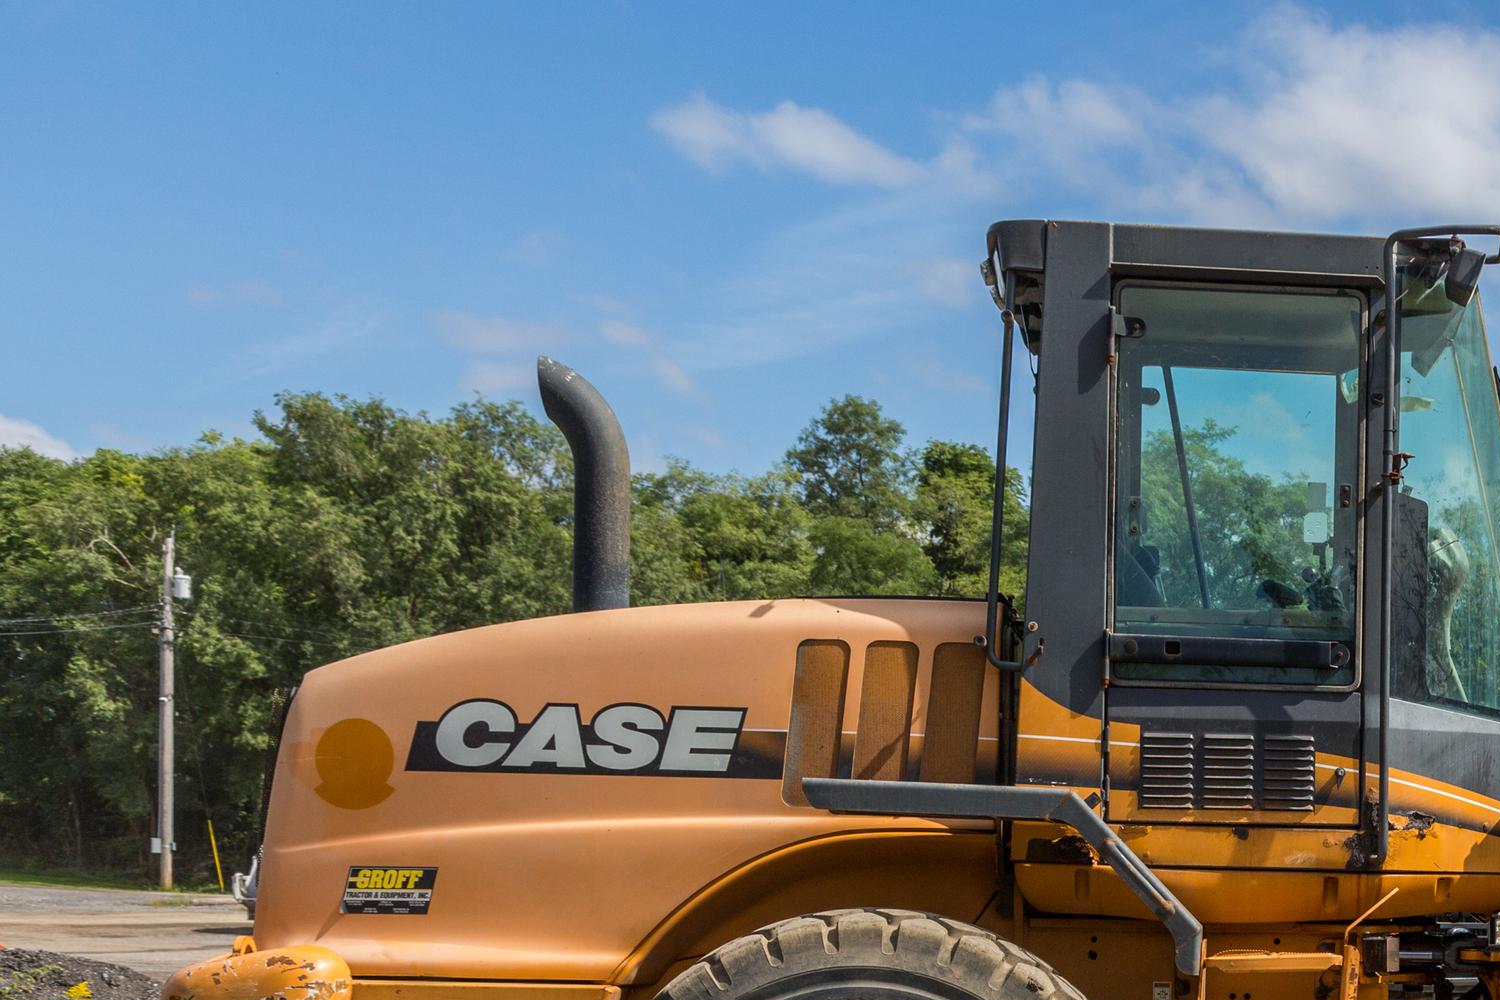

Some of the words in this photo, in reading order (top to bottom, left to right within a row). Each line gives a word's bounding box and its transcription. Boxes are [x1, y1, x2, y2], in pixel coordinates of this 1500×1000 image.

[435, 700, 745, 772] CASE
[356, 869, 423, 889] GROFF
[346, 891, 373, 899] TRACTOR
